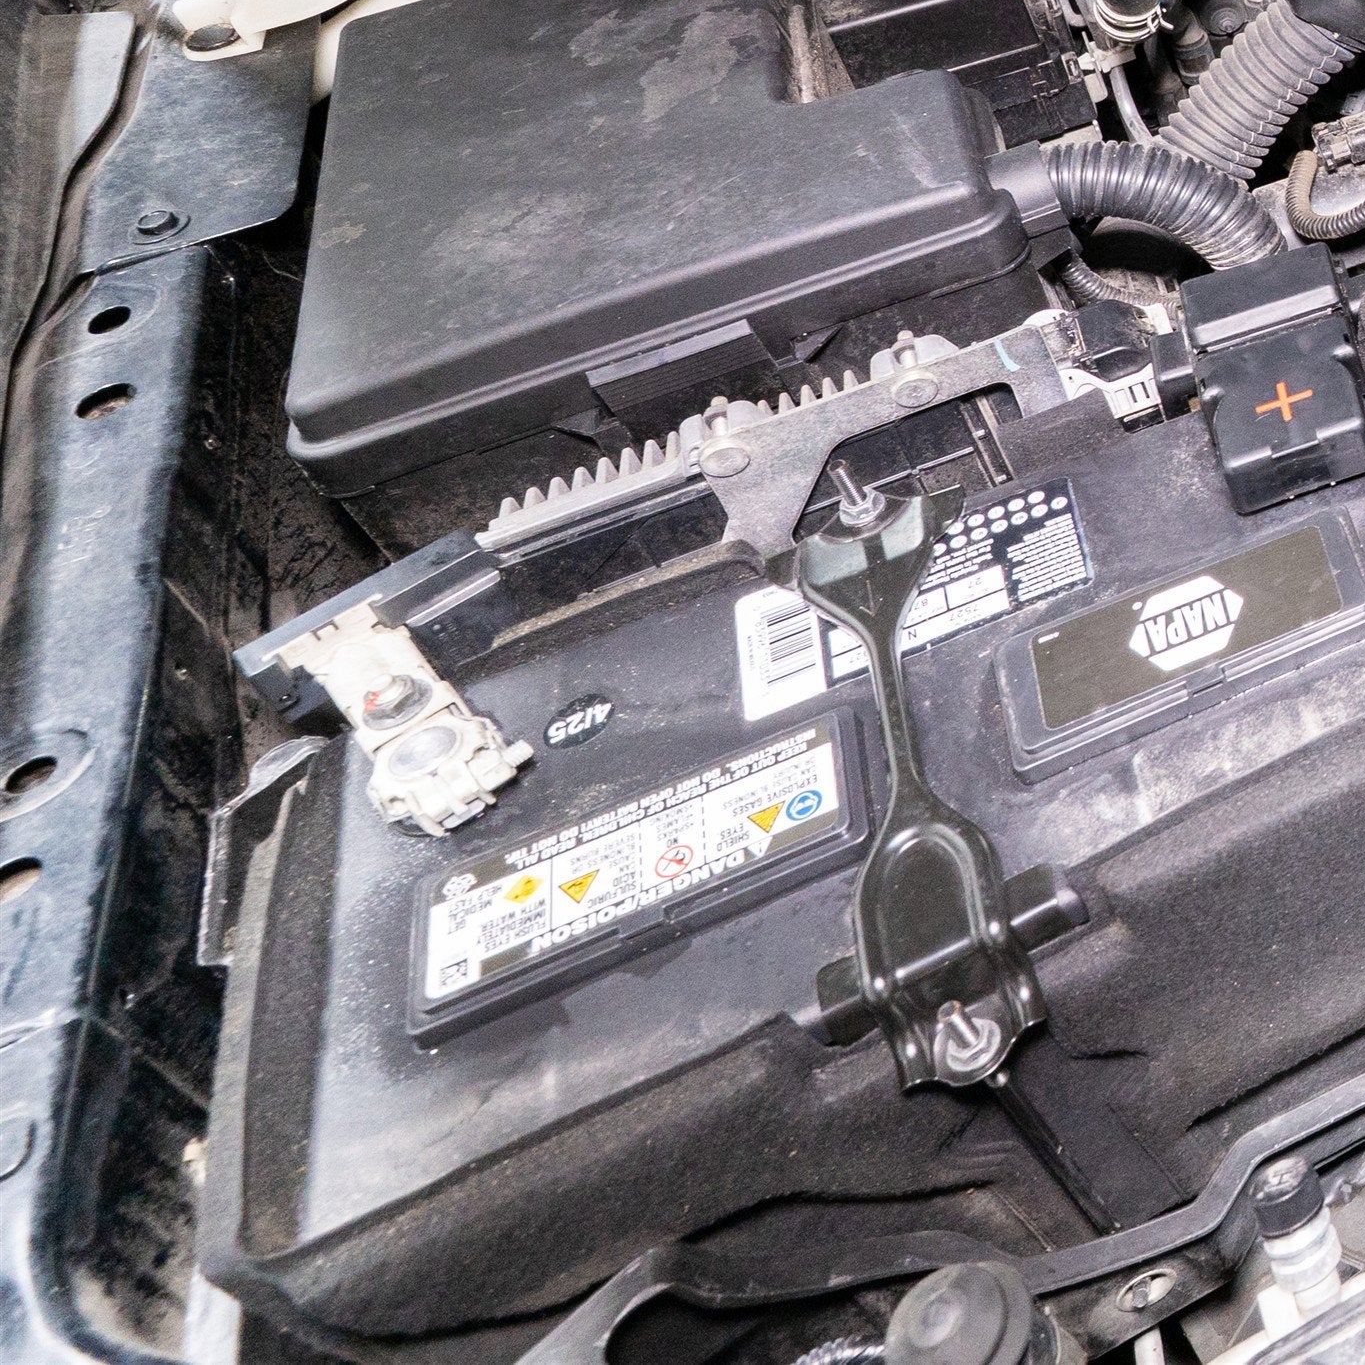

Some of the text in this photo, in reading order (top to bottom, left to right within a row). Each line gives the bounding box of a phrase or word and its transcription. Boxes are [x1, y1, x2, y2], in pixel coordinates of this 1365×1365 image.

[966, 576, 982, 589] 27
[1143, 590, 1234, 656] NAPA
[547, 699, 613, 743] 4/25
[777, 741, 806, 761] KEEP
[752, 755, 772, 771] OUT
[665, 782, 705, 807] REACH
[732, 773, 817, 817] EXPLOSIVE GASES
[666, 835, 678, 847] NO
[716, 830, 749, 852] SHIELD
[612, 870, 635, 887] ACID
[477, 883, 501, 900] HELP
[531, 847, 744, 951] DANGER/POISON
[587, 880, 636, 908] SULFURIC
[447, 897, 491, 923] MEDICAL
[521, 897, 545, 915] WITH
[447, 918, 465, 934] GET
[476, 907, 545, 944] IMMEDIATELY
[484, 918, 545, 952] FLUSH EYES
